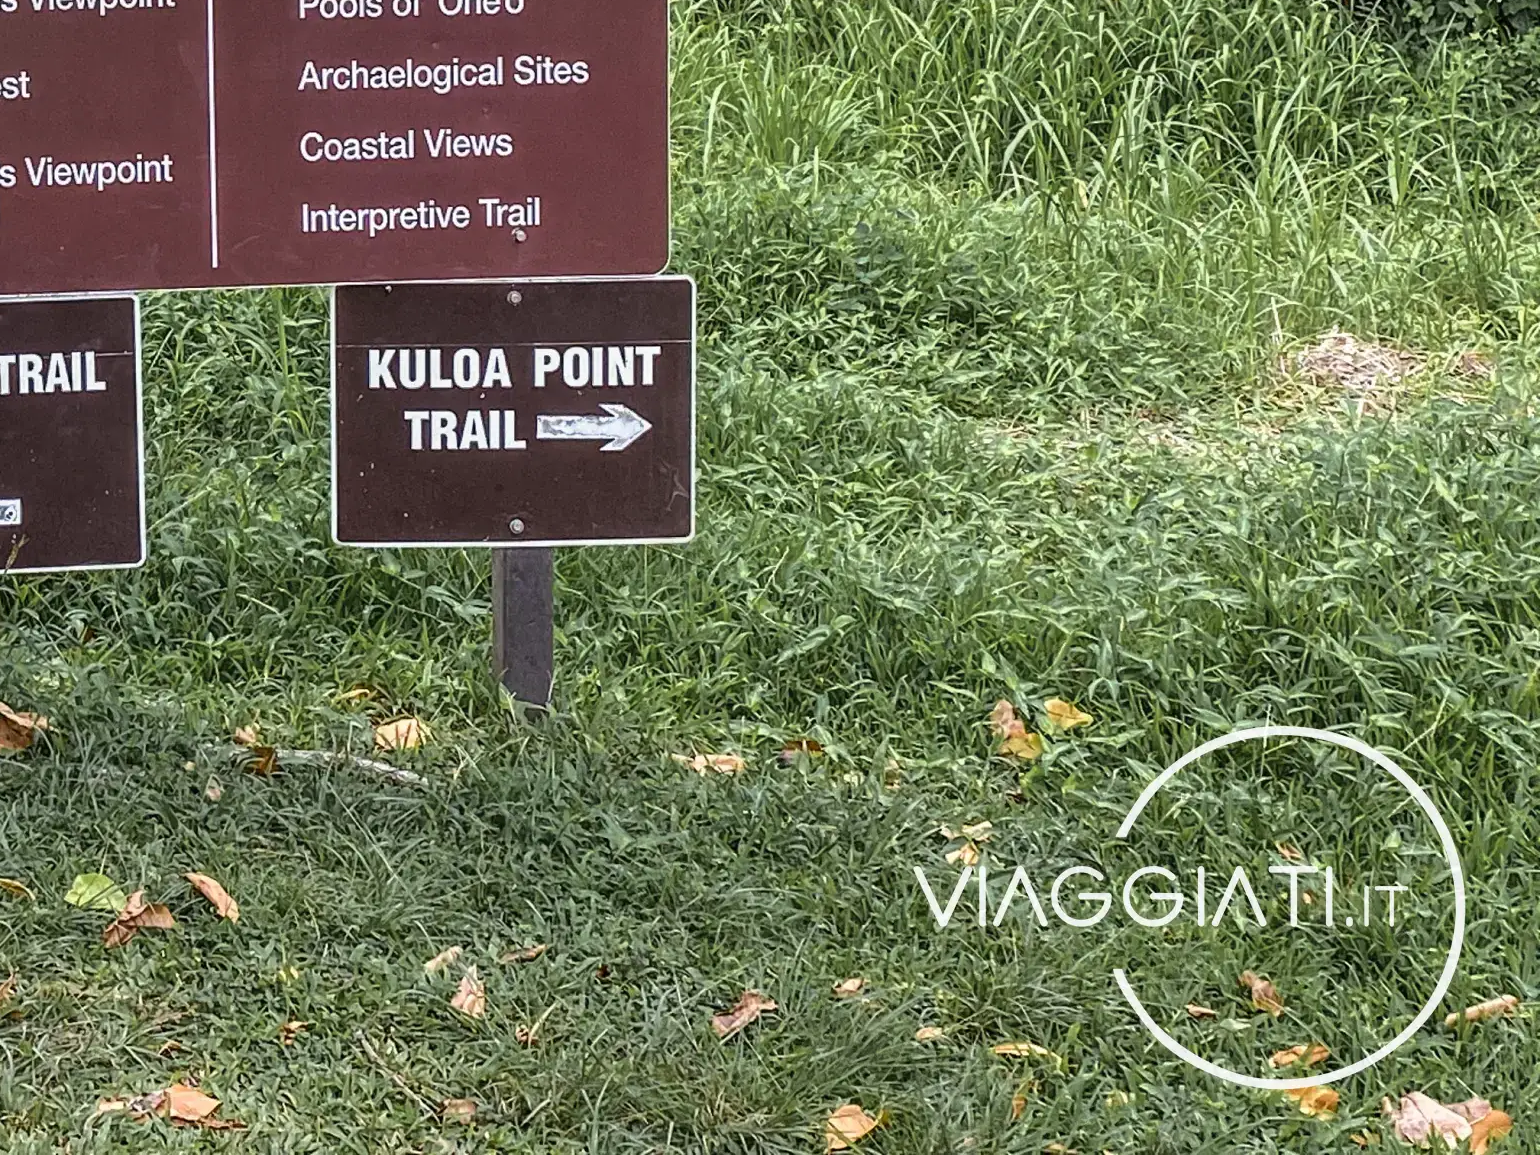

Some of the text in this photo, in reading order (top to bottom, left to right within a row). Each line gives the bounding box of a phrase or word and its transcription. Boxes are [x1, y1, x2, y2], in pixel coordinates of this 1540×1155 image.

[298, 56, 589, 94] Archaelogical Sites
[300, 129, 513, 162] Coastal Views
[25, 154, 173, 195] Viewpoint
[302, 197, 541, 236] Interpretive Trail
[368, 346, 660, 389] KULOA POINT
[404, 410, 527, 450] TRAIL
